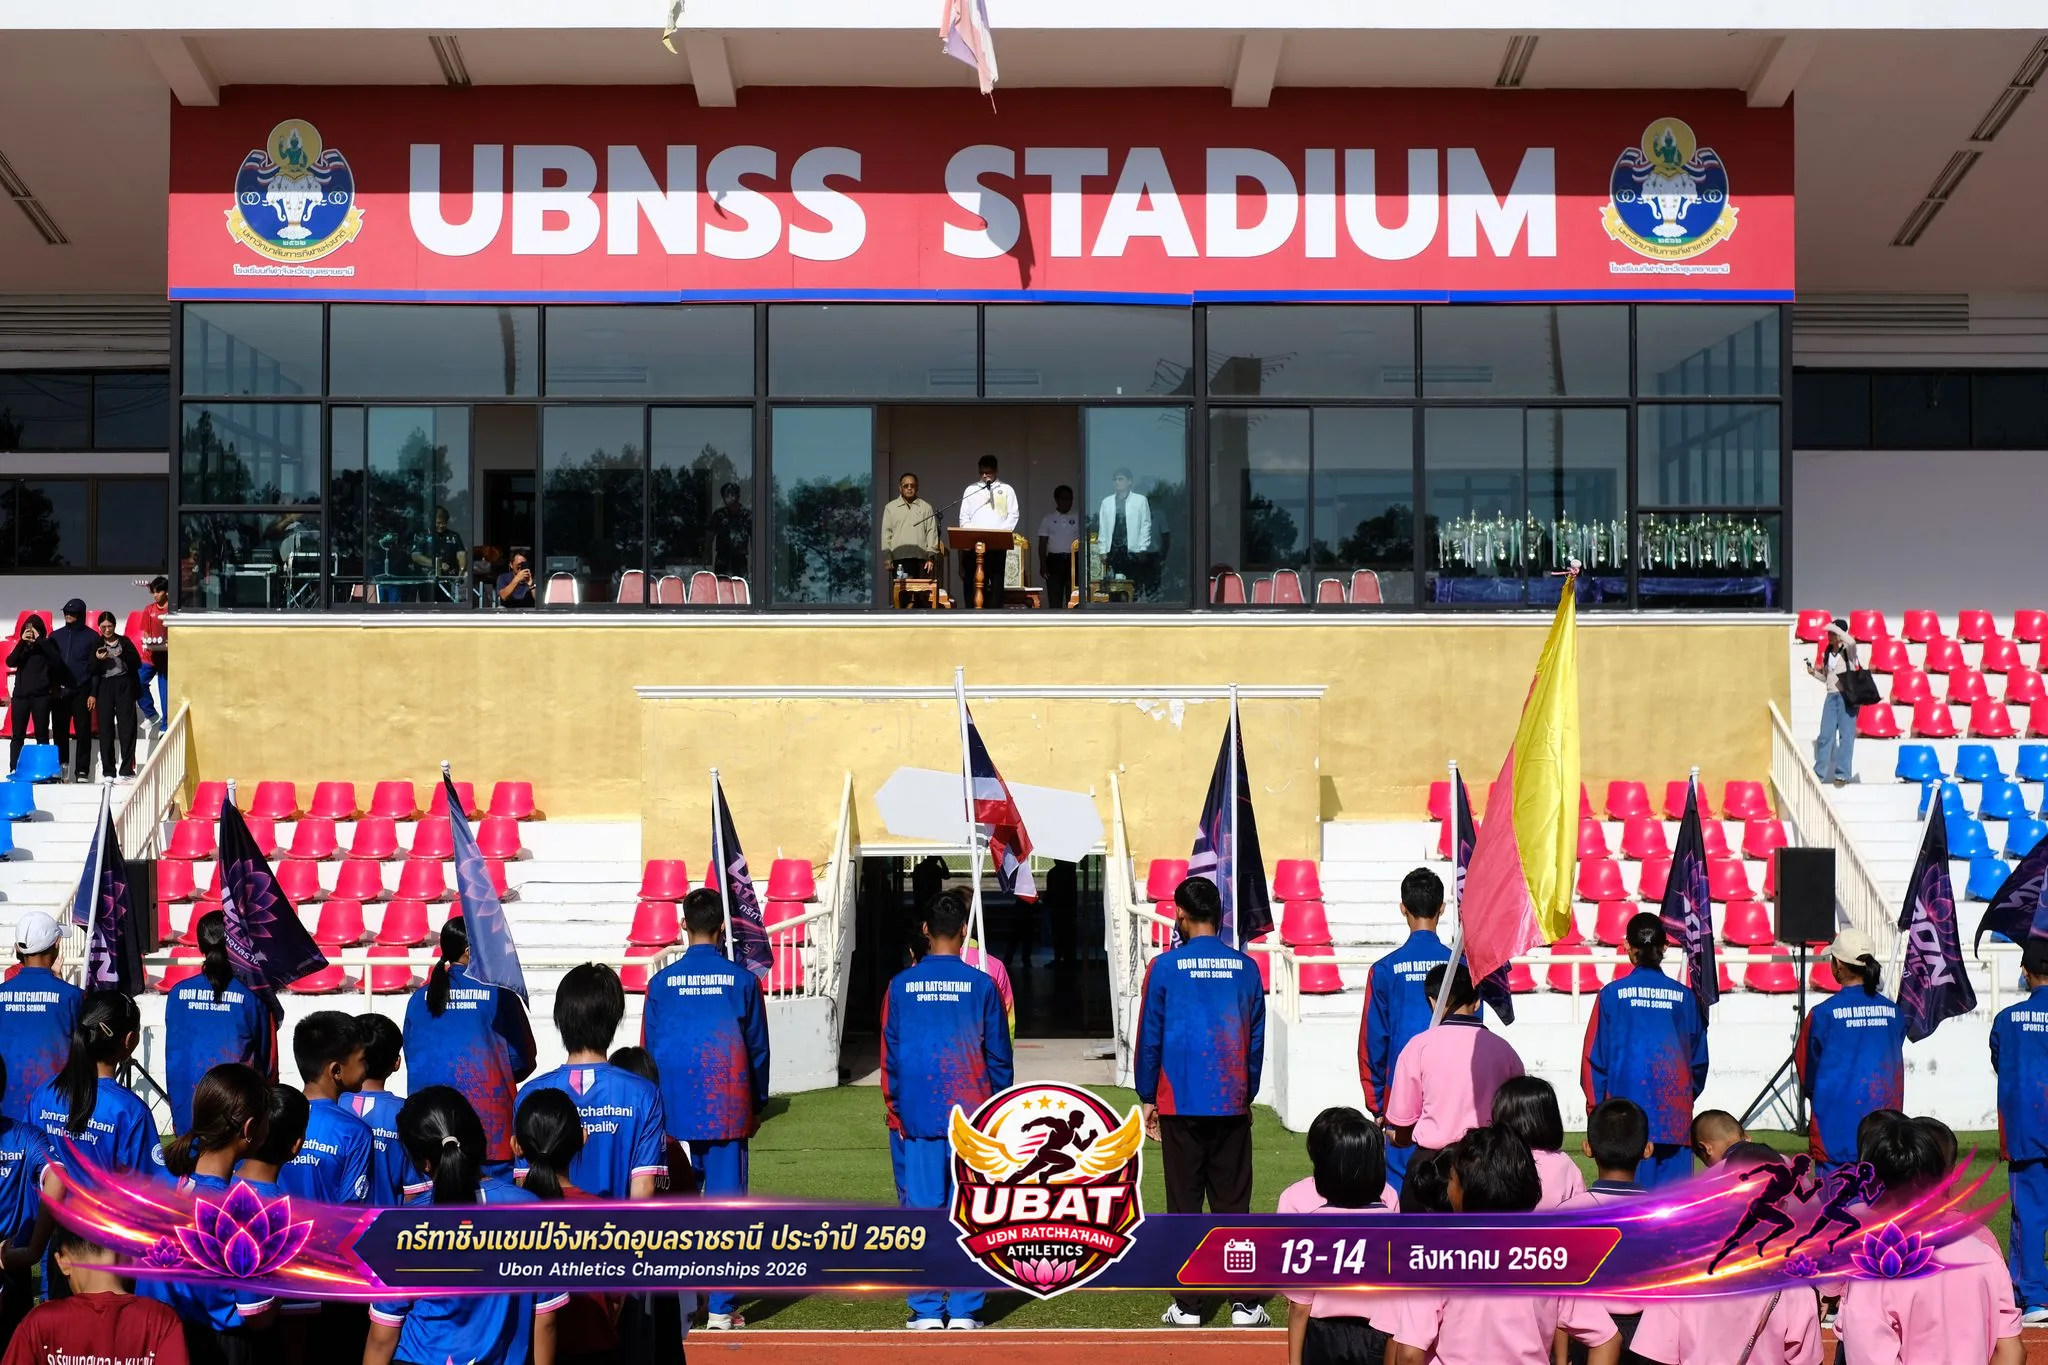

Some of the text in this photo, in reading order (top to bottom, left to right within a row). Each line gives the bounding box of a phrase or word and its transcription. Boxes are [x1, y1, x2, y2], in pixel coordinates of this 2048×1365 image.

[409, 143, 1557, 261] UBNSS STADIUM
[1178, 958, 1243, 970] UBON RATCHATHANI
[1393, 961, 1412, 974] UBON
[667, 974, 734, 987] UBON RATCHATHANI
[1405, 973, 1426, 982] SPORTS
[679, 987, 722, 995] SPORTS SCHOOL
[905, 981, 972, 993] UBON RATCHATHANI
[0, 991, 60, 1004] BON RATCHATHANI
[179, 989, 197, 1000] UBON
[916, 993, 959, 1002] SPORTS SCHOOL
[1618, 987, 1683, 1002] UBON RATCHATHANI
[5, 1004, 46, 1012] SPORTS SCHOOL
[188, 1002, 231, 1011] SPORTS SCHOOL
[456, 1001, 477, 1010] SCHOOL
[1630, 999, 1673, 1009] SPORTS SCHOOL
[1832, 1005, 1896, 1019] UBON RATCHATHANI
[2011, 1011, 2030, 1023] UBON
[1846, 1018, 1888, 1028] SPORTS SCHOOL
[2022, 1023, 2045, 1032] SPORTS
